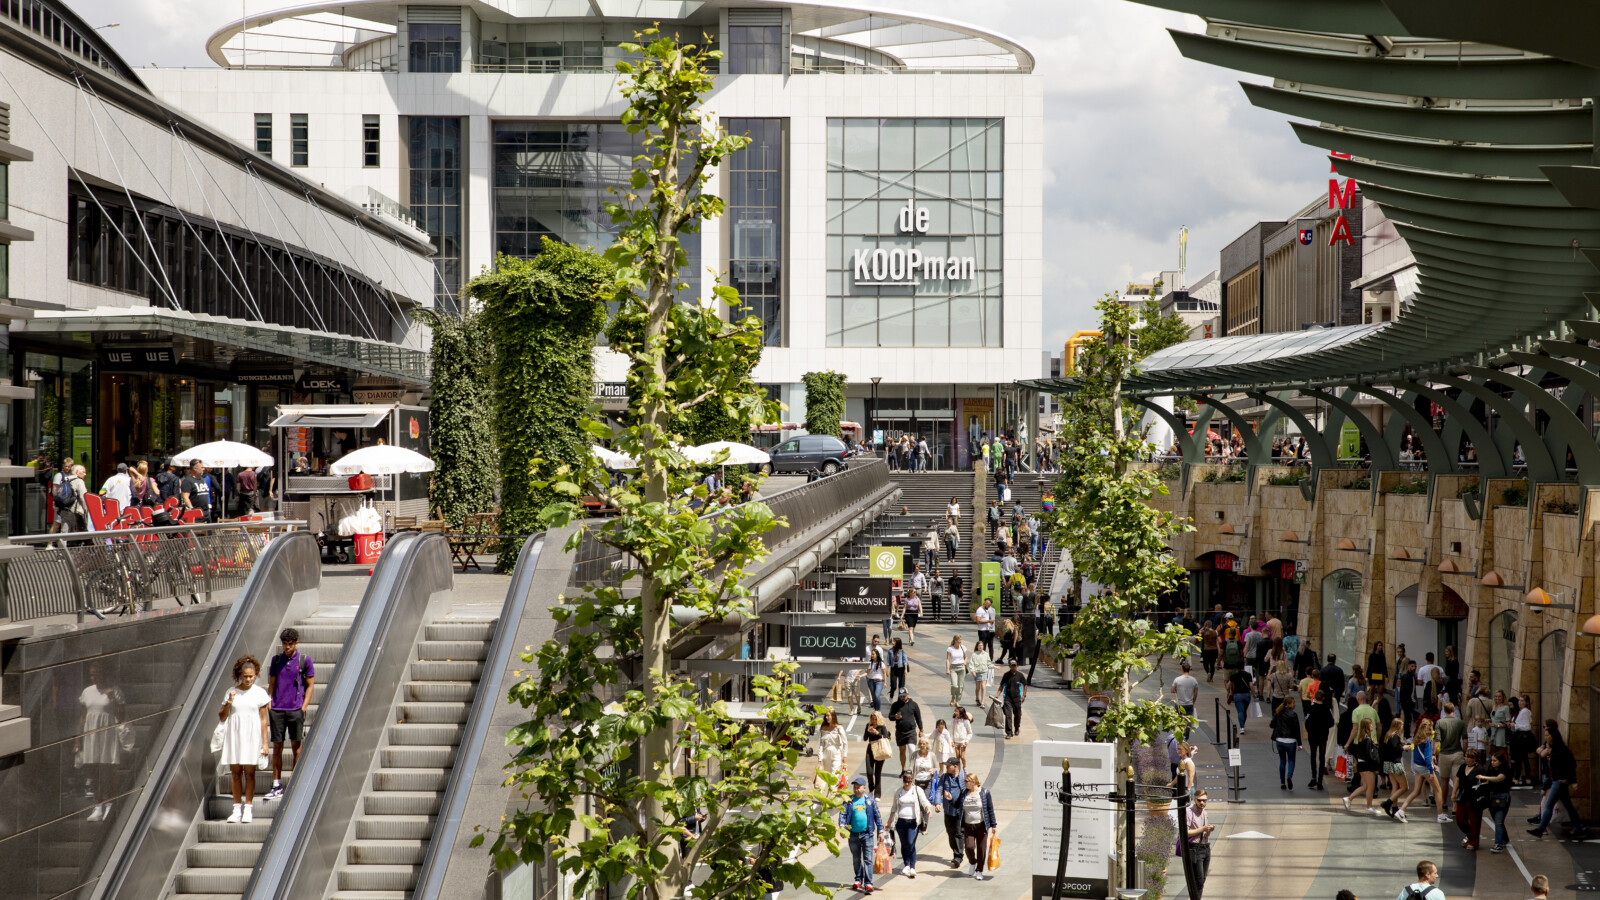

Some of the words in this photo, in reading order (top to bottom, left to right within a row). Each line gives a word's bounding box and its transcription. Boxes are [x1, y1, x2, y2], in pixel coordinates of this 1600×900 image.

[899, 198, 931, 234] de
[853, 247, 976, 282] KOOPman
[108, 352, 133, 363] WE
[145, 351, 170, 362] WE
[237, 374, 295, 382] DUNGELMANN
[302, 379, 341, 389] LOEK.
[366, 391, 399, 400] DIAMOR
[1296, 561, 1303, 571] P
[839, 596, 888, 607] SWAROVSKI
[799, 635, 857, 649] DOUGLAS
[1051, 882, 1092, 891] KOPGOOT
